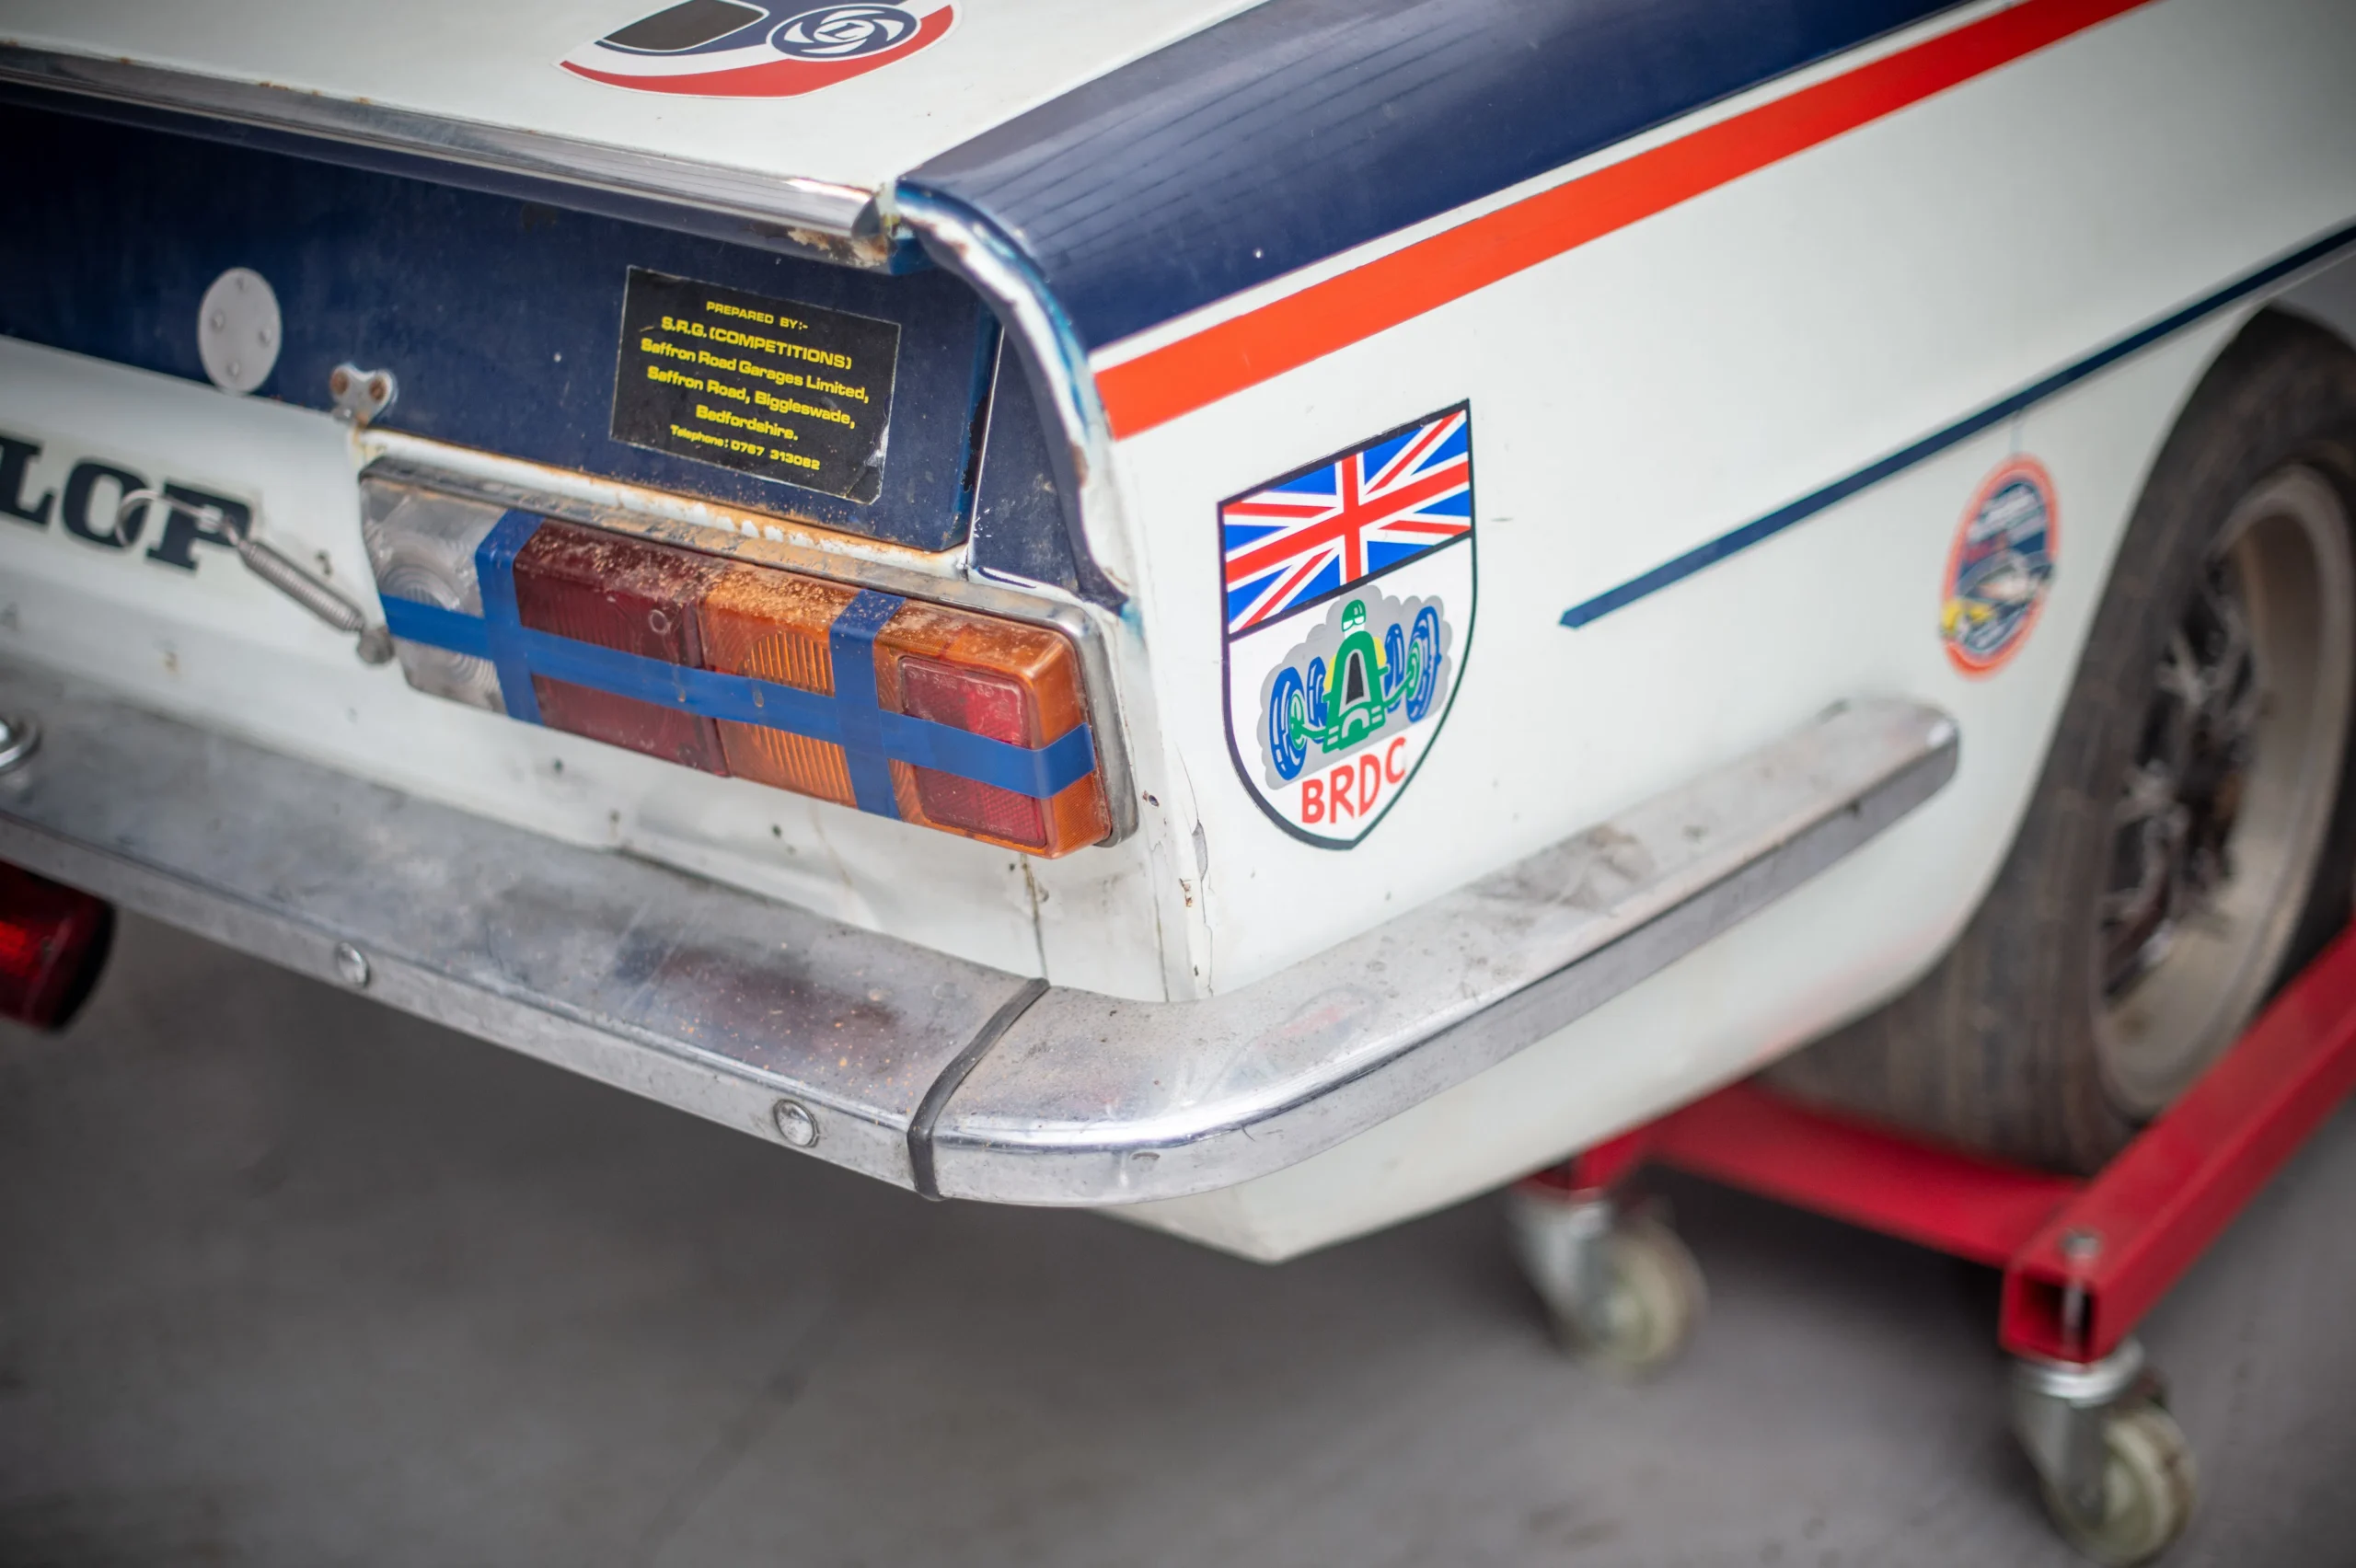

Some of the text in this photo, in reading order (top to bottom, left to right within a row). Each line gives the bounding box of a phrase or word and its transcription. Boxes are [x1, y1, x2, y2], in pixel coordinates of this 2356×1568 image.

[817, 22, 866, 40] L
[706, 301, 774, 325] PREPARED
[661, 316, 852, 370] S.R.G. (COMPETITIONS)
[641, 338, 870, 404] Saffron Road Garages Limited,
[647, 365, 856, 430] Saffron Road, Biggleswade,
[696, 404, 799, 441] Bedfordshire.
[670, 424, 821, 471] Telephone: 0767 313082
[1301, 736, 1406, 824] BRDC
